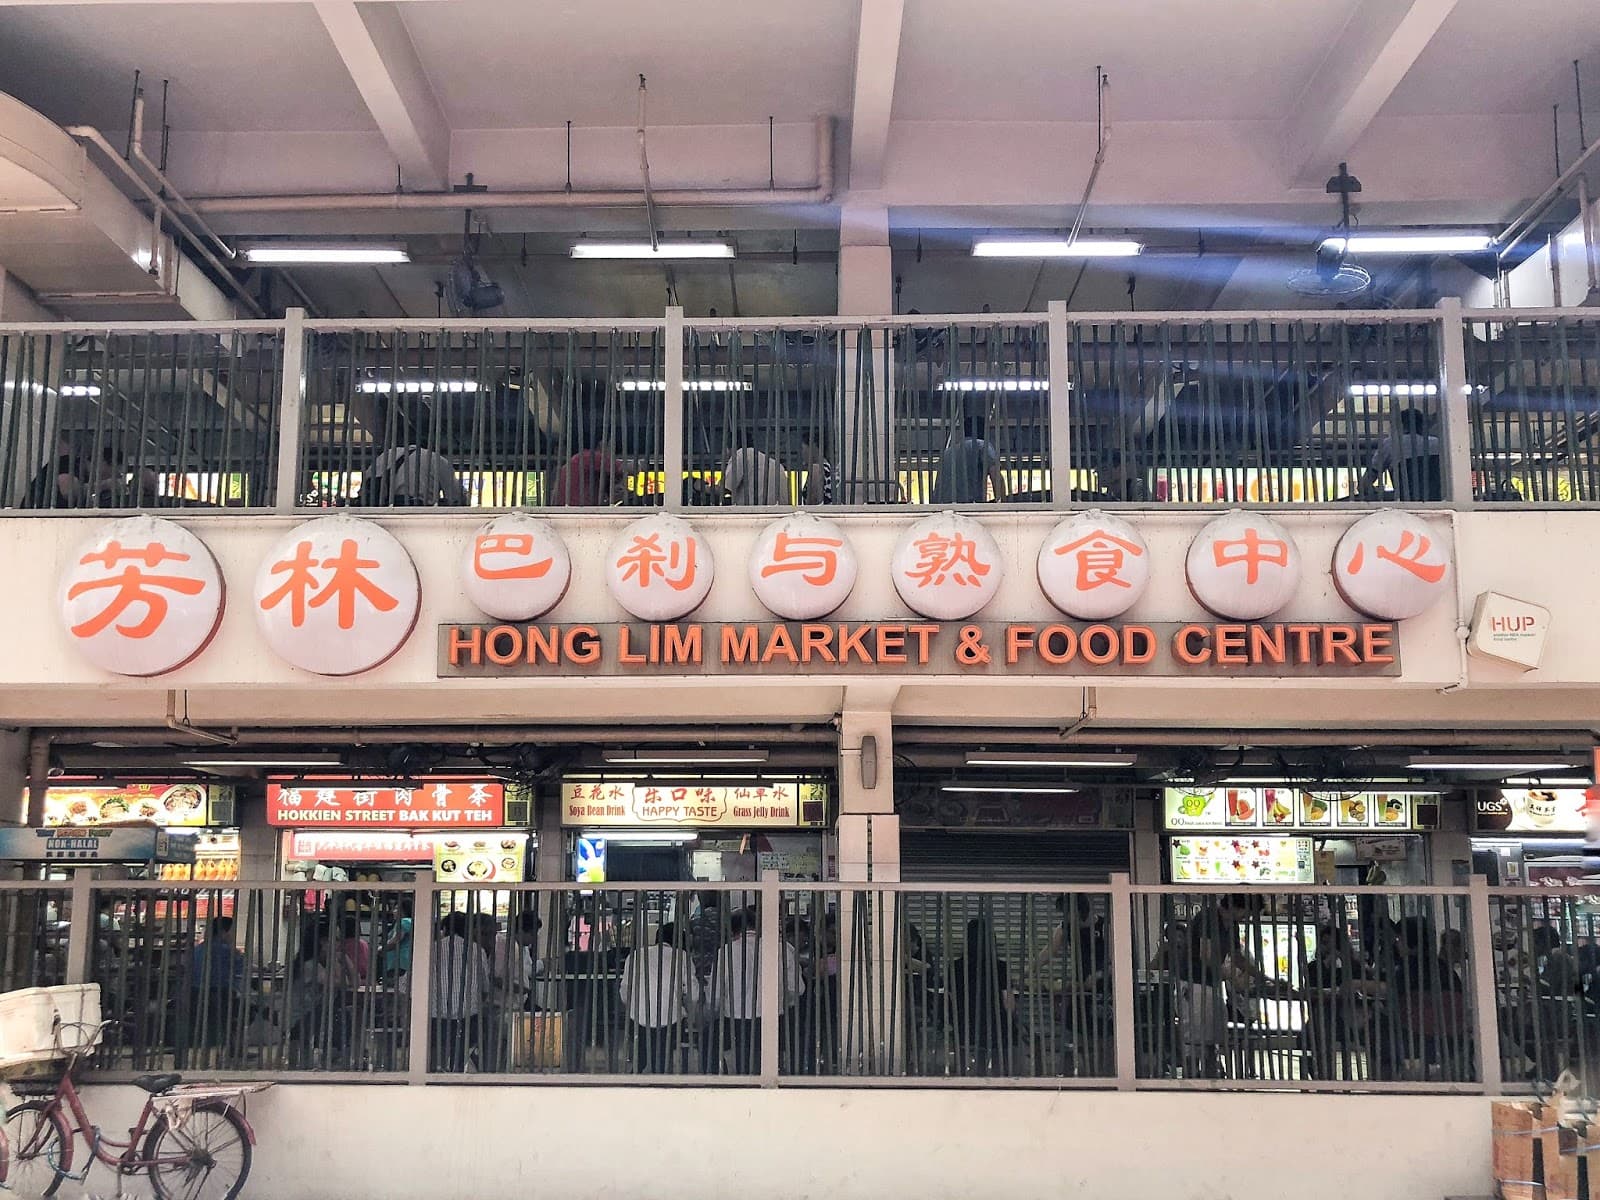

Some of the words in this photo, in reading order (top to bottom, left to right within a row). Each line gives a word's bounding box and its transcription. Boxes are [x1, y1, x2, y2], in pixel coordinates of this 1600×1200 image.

[1491, 616, 1536, 632] HUP
[448, 624, 601, 665] HONG
[618, 624, 703, 664] LIM
[720, 623, 941, 664] MARKET
[956, 624, 991, 664] &
[1005, 624, 1157, 664] FOOD
[1174, 623, 1396, 664] CENTRE
[571, 784, 625, 800] 豆花水
[643, 786, 716, 804] 乐口味
[733, 785, 790, 802] 仙草水
[277, 809, 342, 822] HOKKIEN
[345, 809, 396, 822] STREET
[398, 809, 430, 822] BAK
[432, 809, 462, 822] KUT
[464, 809, 493, 822] TEH
[569, 805, 585, 817] Soya
[587, 805, 605, 816] Bean
[606, 805, 626, 816] Drink
[642, 806, 680, 817] HAPPY
[683, 806, 718, 817] TASTE
[733, 806, 752, 818] Grass
[753, 806, 769, 819] Jelly
[770, 806, 790, 818] Drink
[47, 837, 99, 850] NON-HALAL
